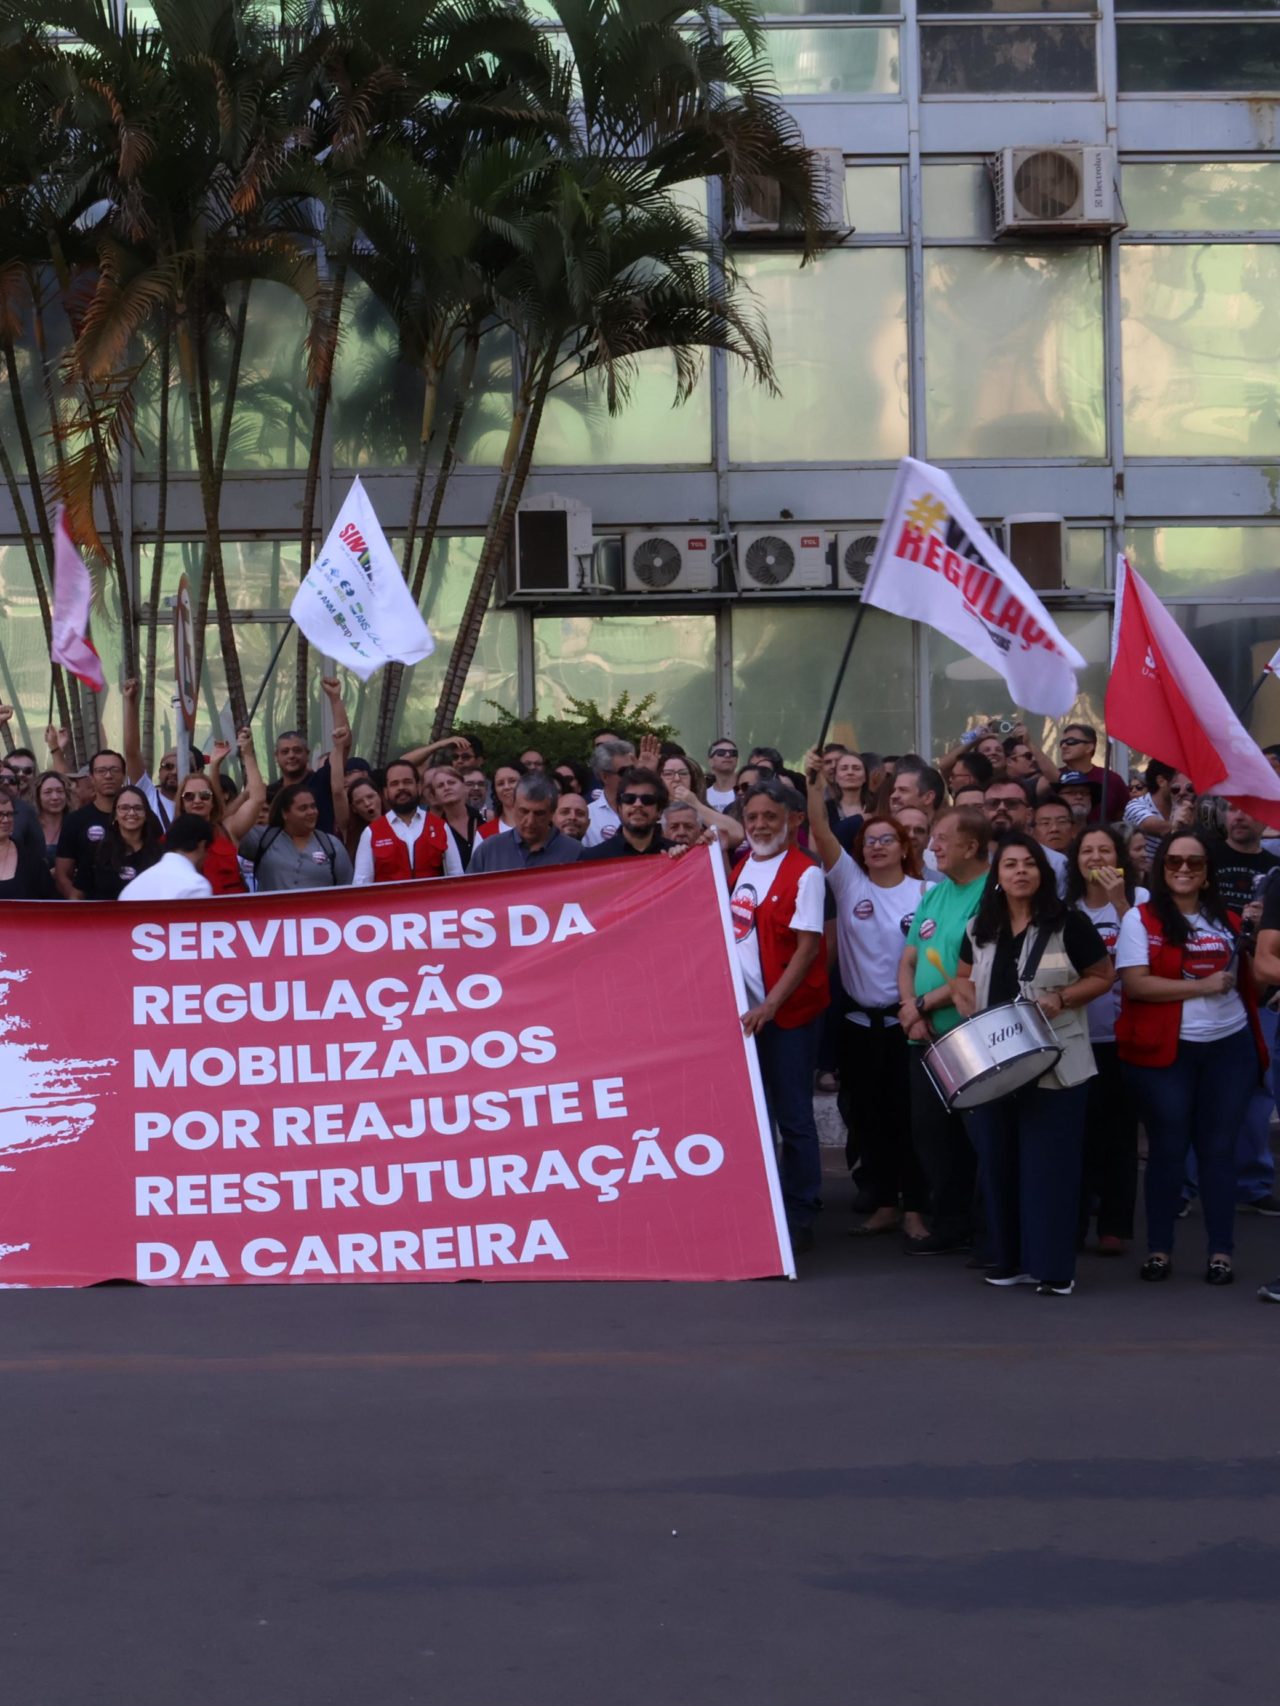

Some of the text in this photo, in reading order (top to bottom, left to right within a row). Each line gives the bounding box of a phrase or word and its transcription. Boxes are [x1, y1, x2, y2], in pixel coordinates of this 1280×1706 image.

[895, 520, 1065, 657] REGULAÇ
[131, 903, 597, 962] SERVIDORES DA
[132, 964, 503, 1031] REGULAÇÃO
[133, 1025, 556, 1089] MOBILIZADOS
[988, 1021, 1024, 1048] GOPE
[134, 1077, 628, 1152] POR REAJUSTE E
[135, 1127, 725, 1217] REESTRUTURAÇÃO
[136, 1218, 569, 1281] DA CARREIRA
